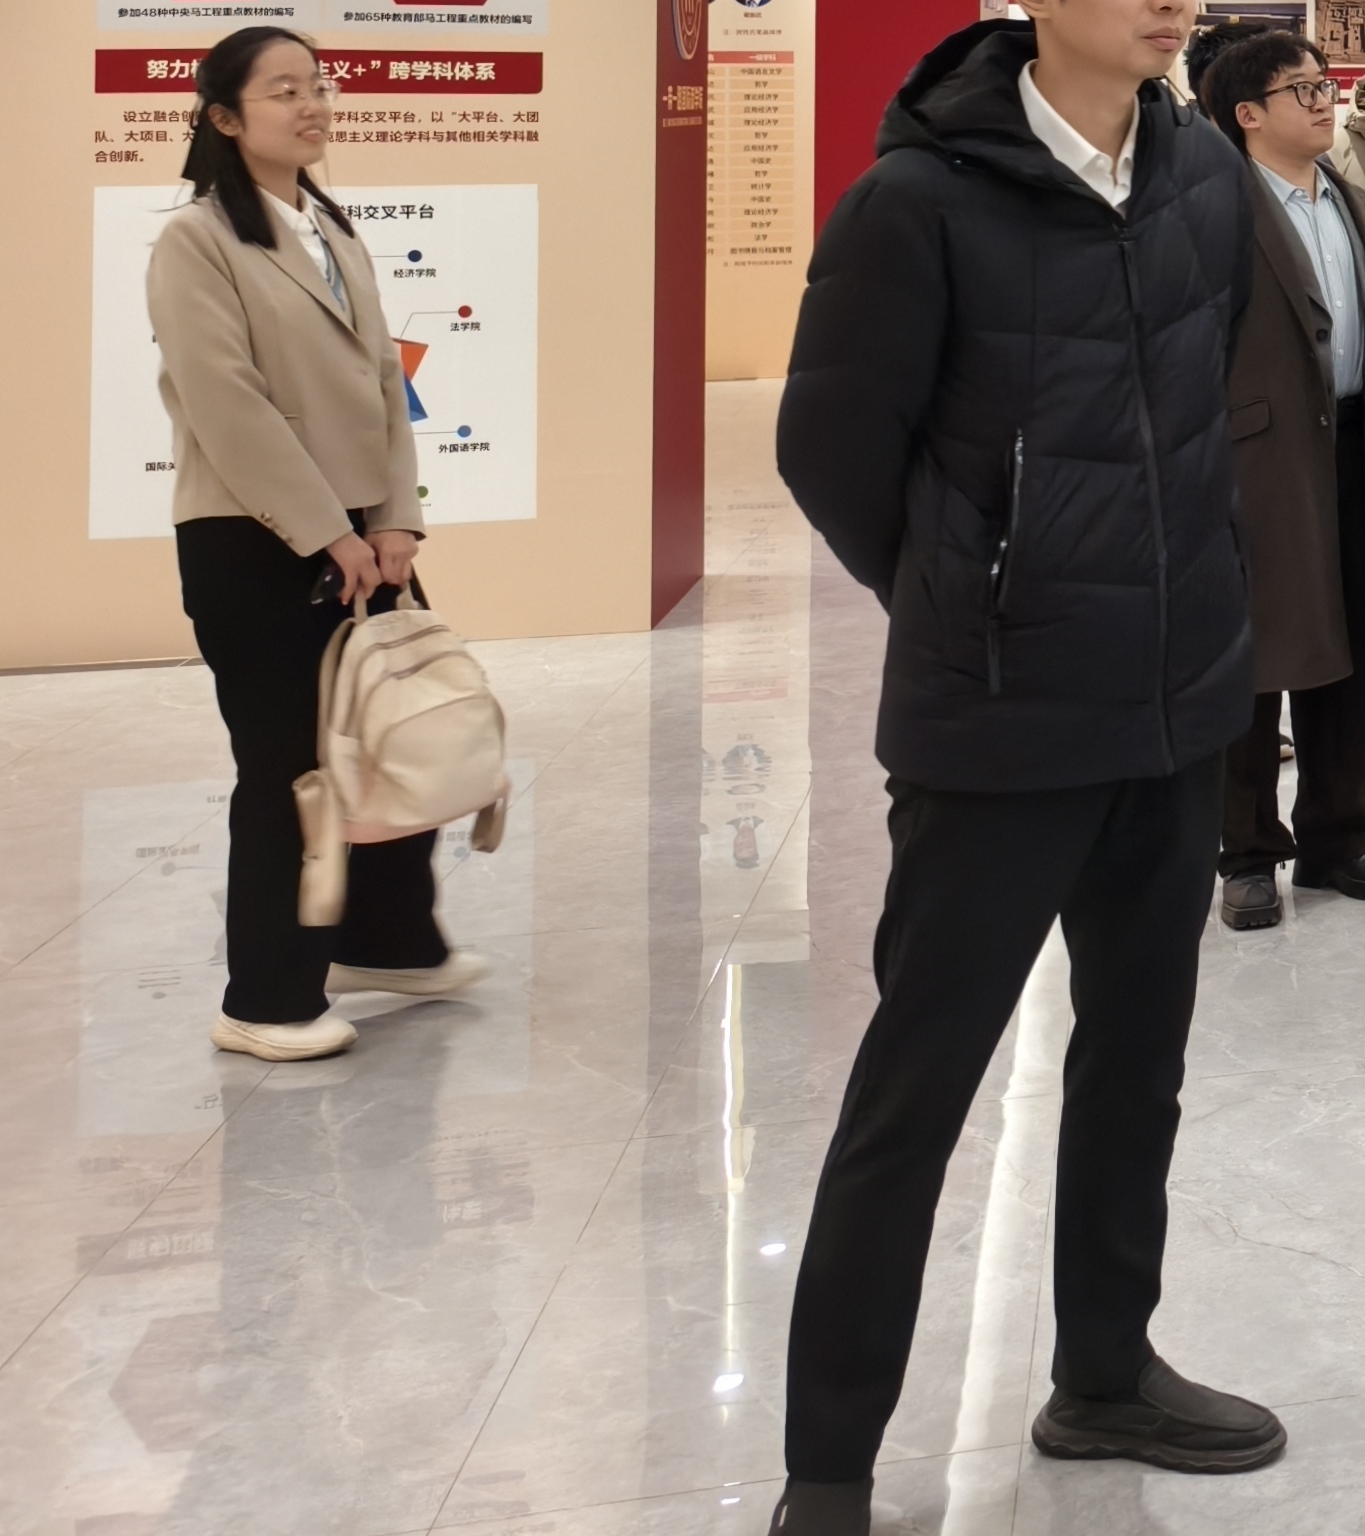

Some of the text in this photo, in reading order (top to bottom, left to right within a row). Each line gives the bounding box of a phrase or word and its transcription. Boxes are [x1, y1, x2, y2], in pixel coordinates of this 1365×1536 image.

[118, 7, 295, 18] 参加48种中央马工程重点教材的编写
[344, 11, 532, 24] 参加65种教育部马工程重点教材的编写
[95, 150, 144, 163] 合创新。
[393, 268, 436, 278] 经济学院
[450, 322, 481, 332] 法学院
[438, 442, 490, 453] 外国语学院
